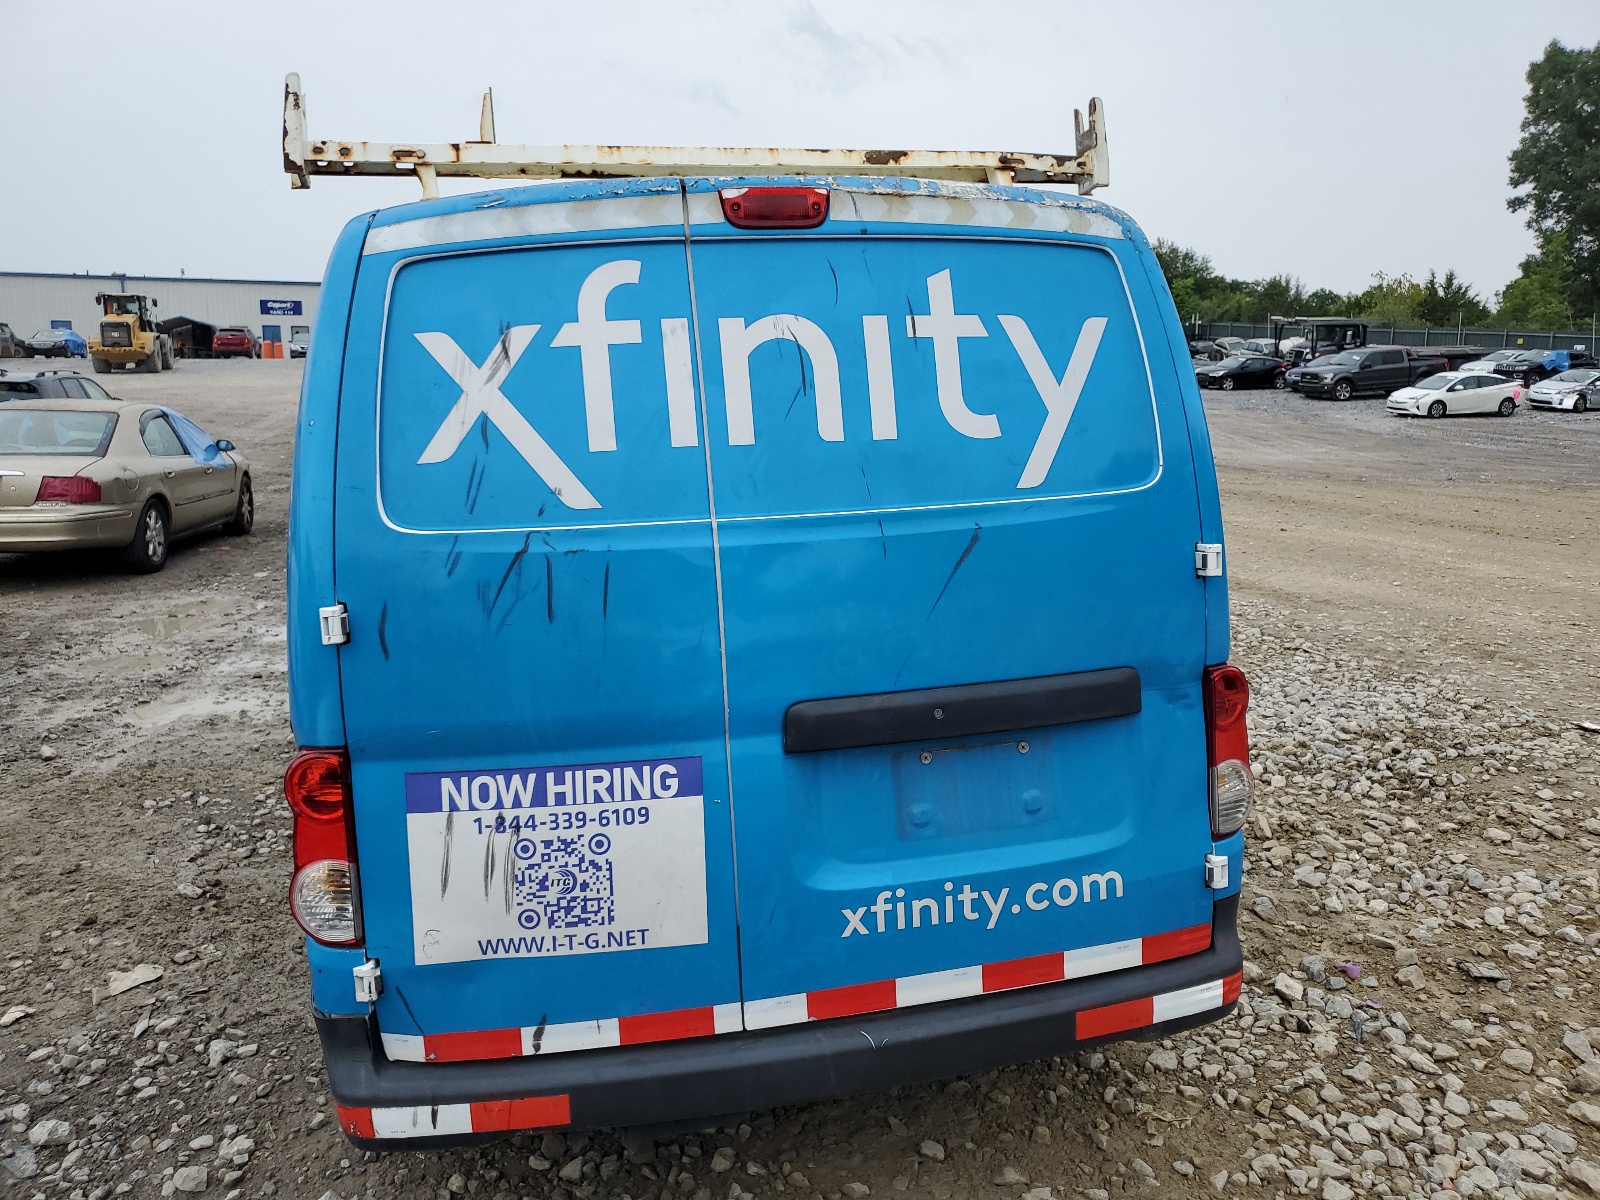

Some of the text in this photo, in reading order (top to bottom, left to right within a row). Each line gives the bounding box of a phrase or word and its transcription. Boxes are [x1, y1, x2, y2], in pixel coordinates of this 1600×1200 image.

[413, 259, 1108, 510] xfinity
[441, 765, 679, 811] NOW HIRING
[473, 807, 650, 835] 1-844-339-6109
[840, 869, 1124, 938] xfinity.com
[478, 928, 650, 956] WWW.I-T-G.NET
